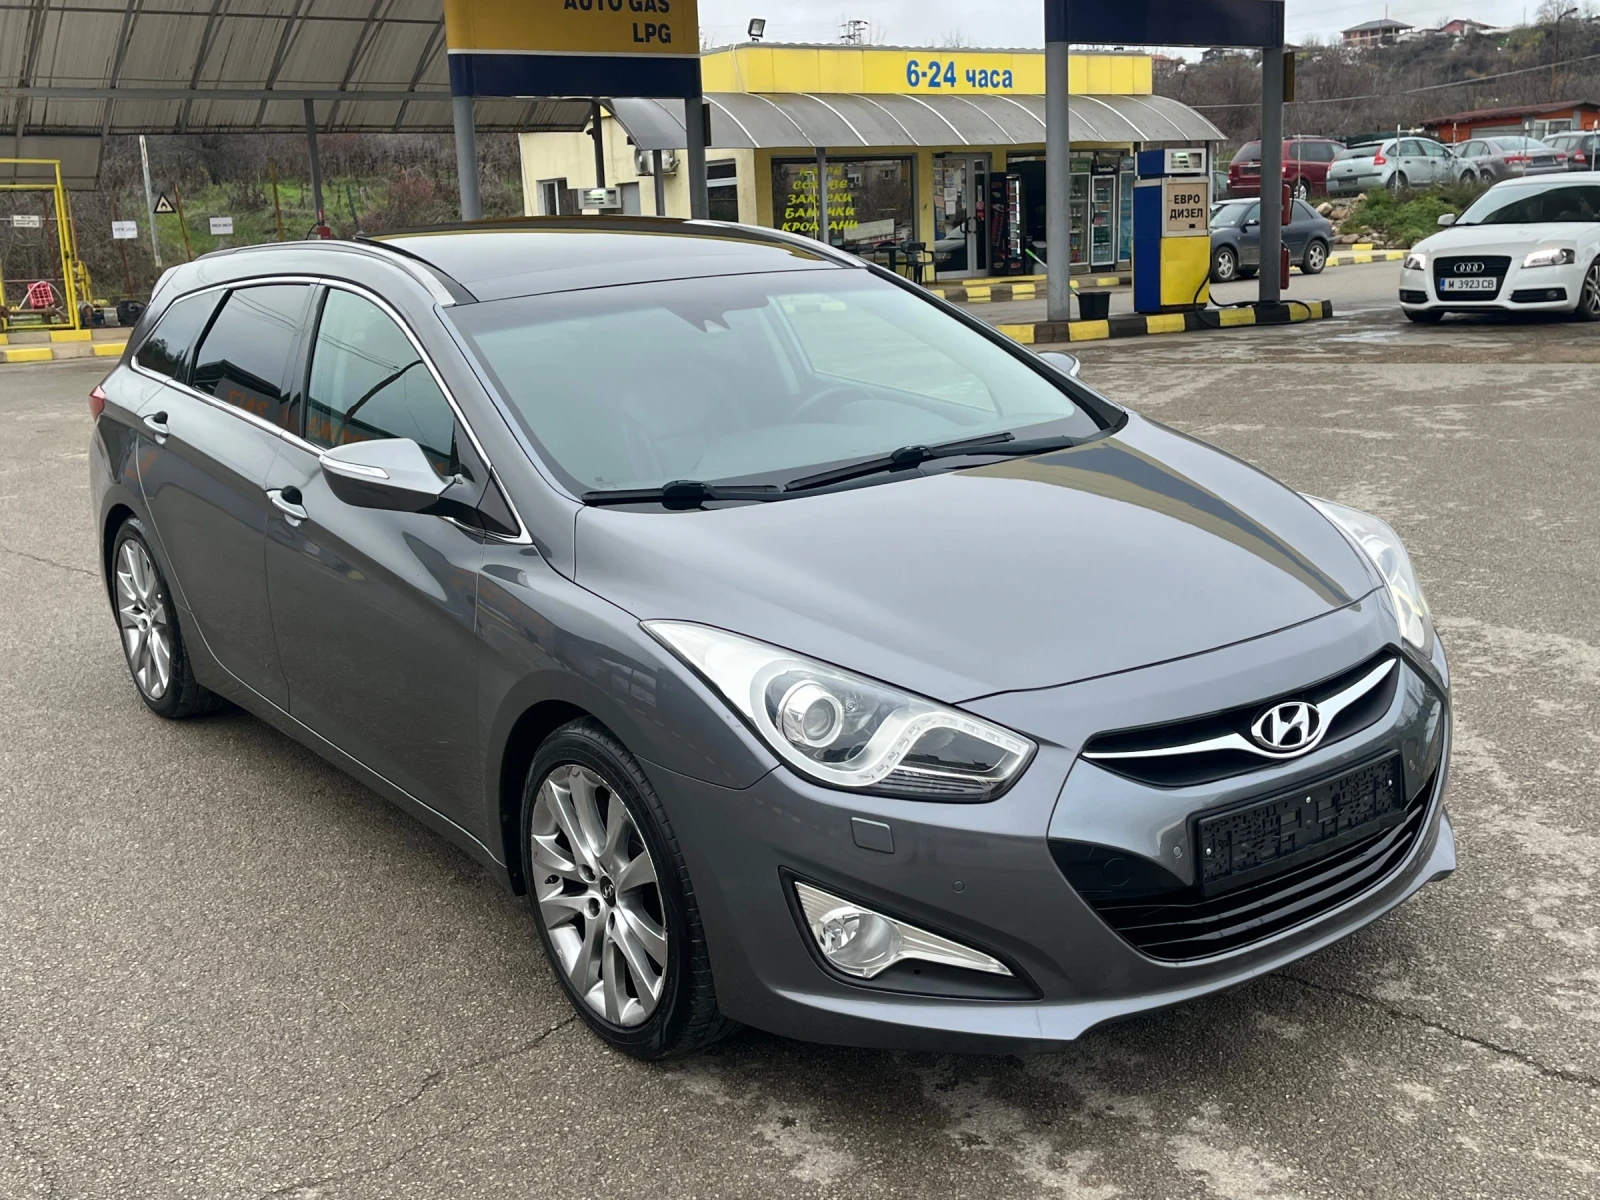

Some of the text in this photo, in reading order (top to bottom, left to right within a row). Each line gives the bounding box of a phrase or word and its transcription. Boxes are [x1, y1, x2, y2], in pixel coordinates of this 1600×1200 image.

[632, 22, 672, 44] LPG
[906, 59, 1013, 89] 6-24 часа
[792, 179, 849, 190] СОКВЕ
[787, 193, 853, 206] ЗАКСКИ
[1174, 194, 1201, 205] ЕВРО
[784, 206, 856, 219] БАНЧКИ
[1170, 208, 1204, 220] ДИЗЕЛ
[781, 220, 859, 232] КРОААНИ
[1458, 280, 1480, 289] 3923
